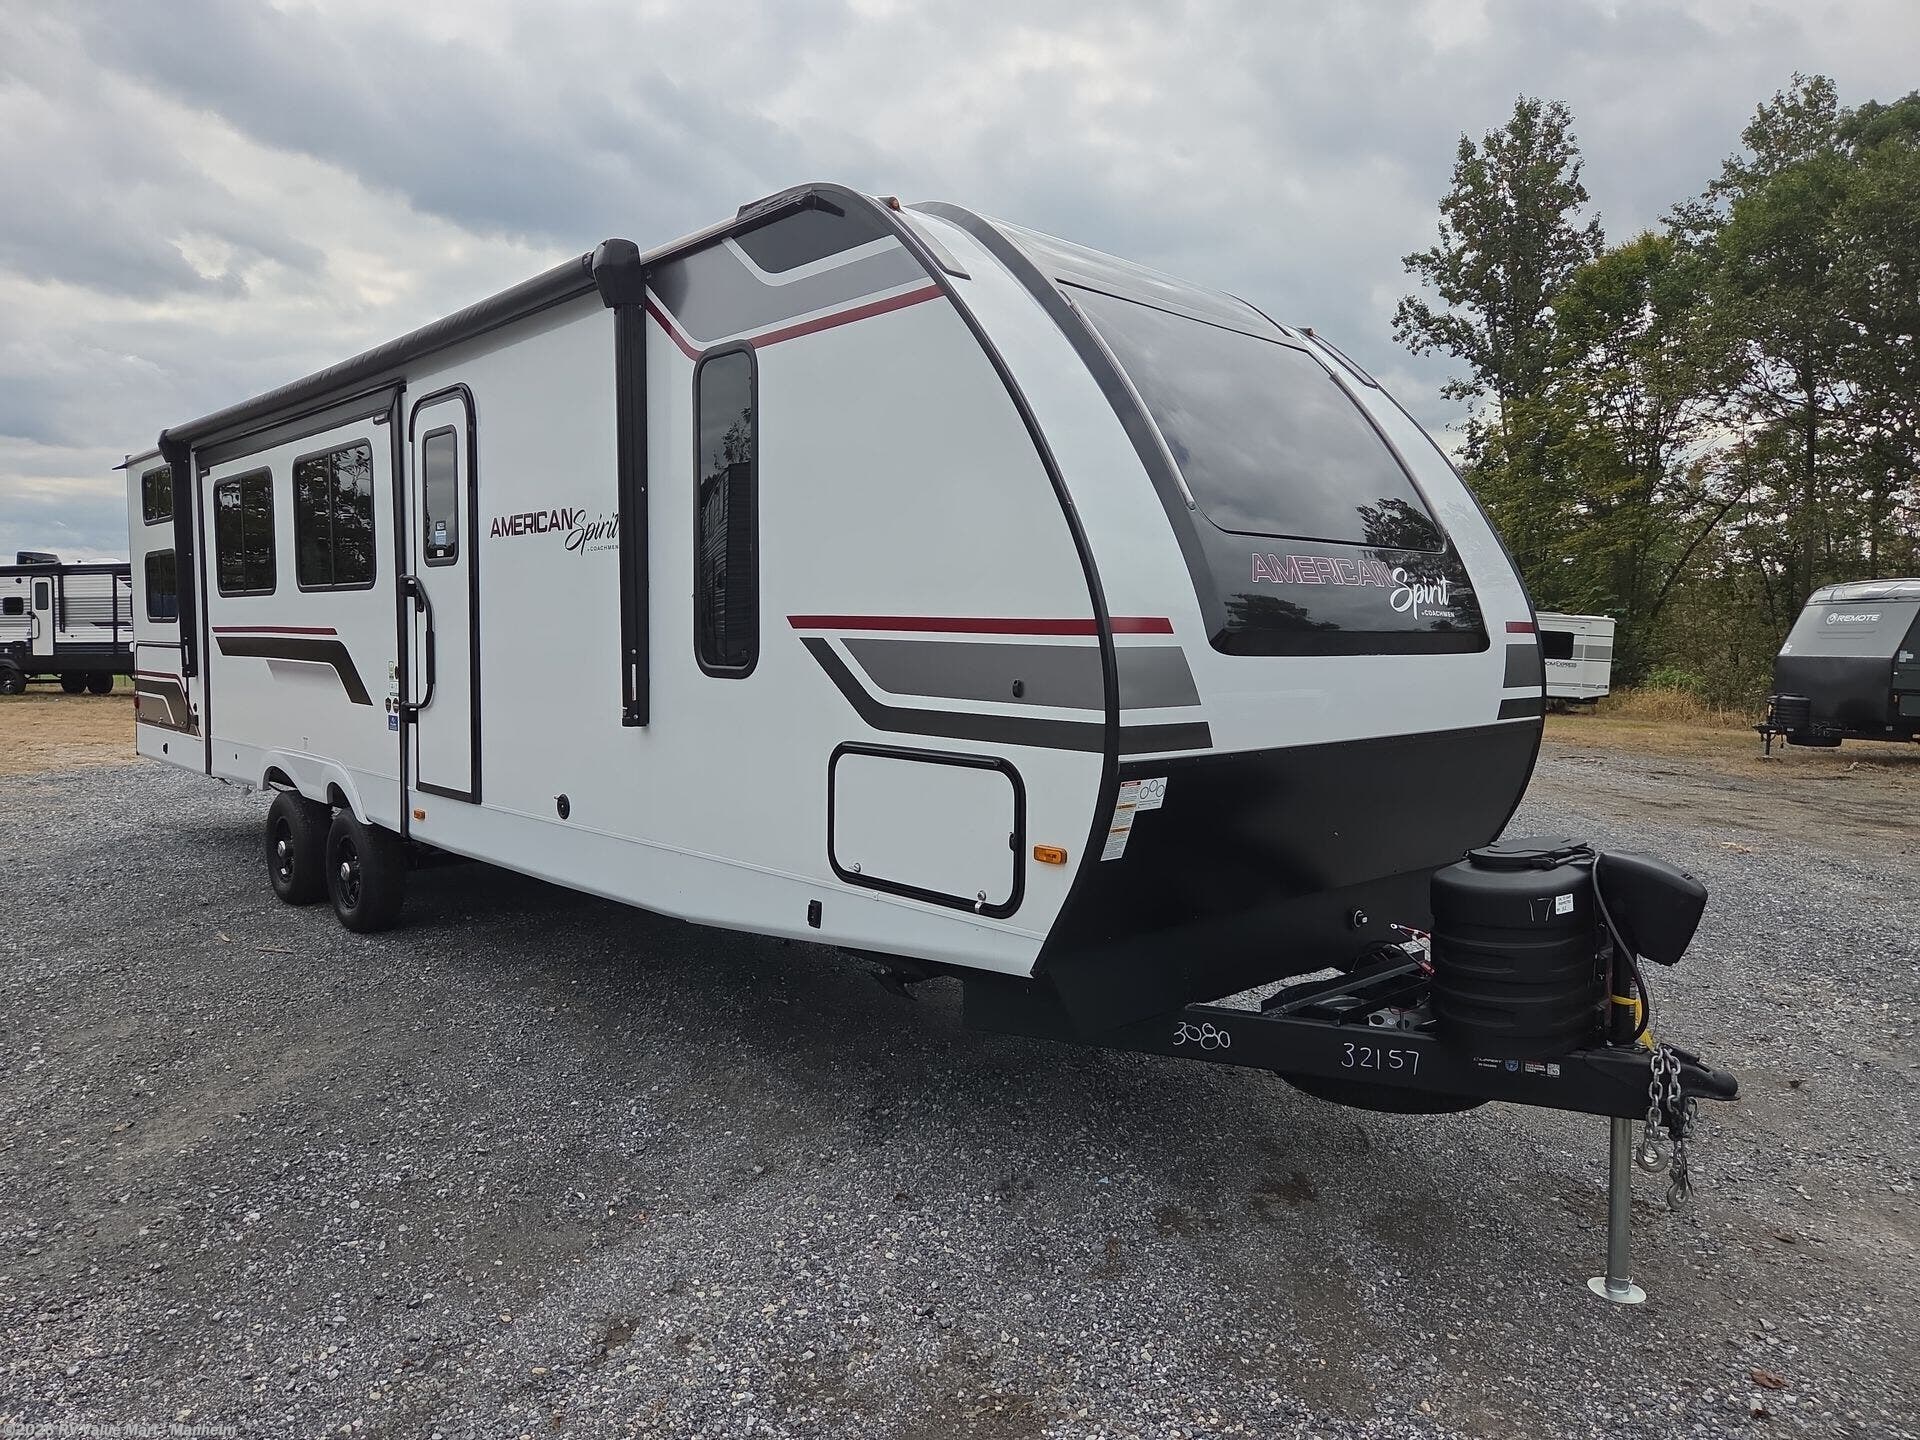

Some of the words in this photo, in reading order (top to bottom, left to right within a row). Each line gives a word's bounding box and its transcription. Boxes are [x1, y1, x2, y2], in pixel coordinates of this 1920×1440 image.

[490, 508, 573, 539] AMERICAN
[564, 509, 619, 556] Spirit
[1251, 553, 1397, 588] AMERICAN
[1389, 567, 1453, 620] Spirit
[1836, 613, 1881, 622] REMOTE
[1172, 1021, 1231, 1050] 3080
[1341, 1042, 1420, 1076] 32157
